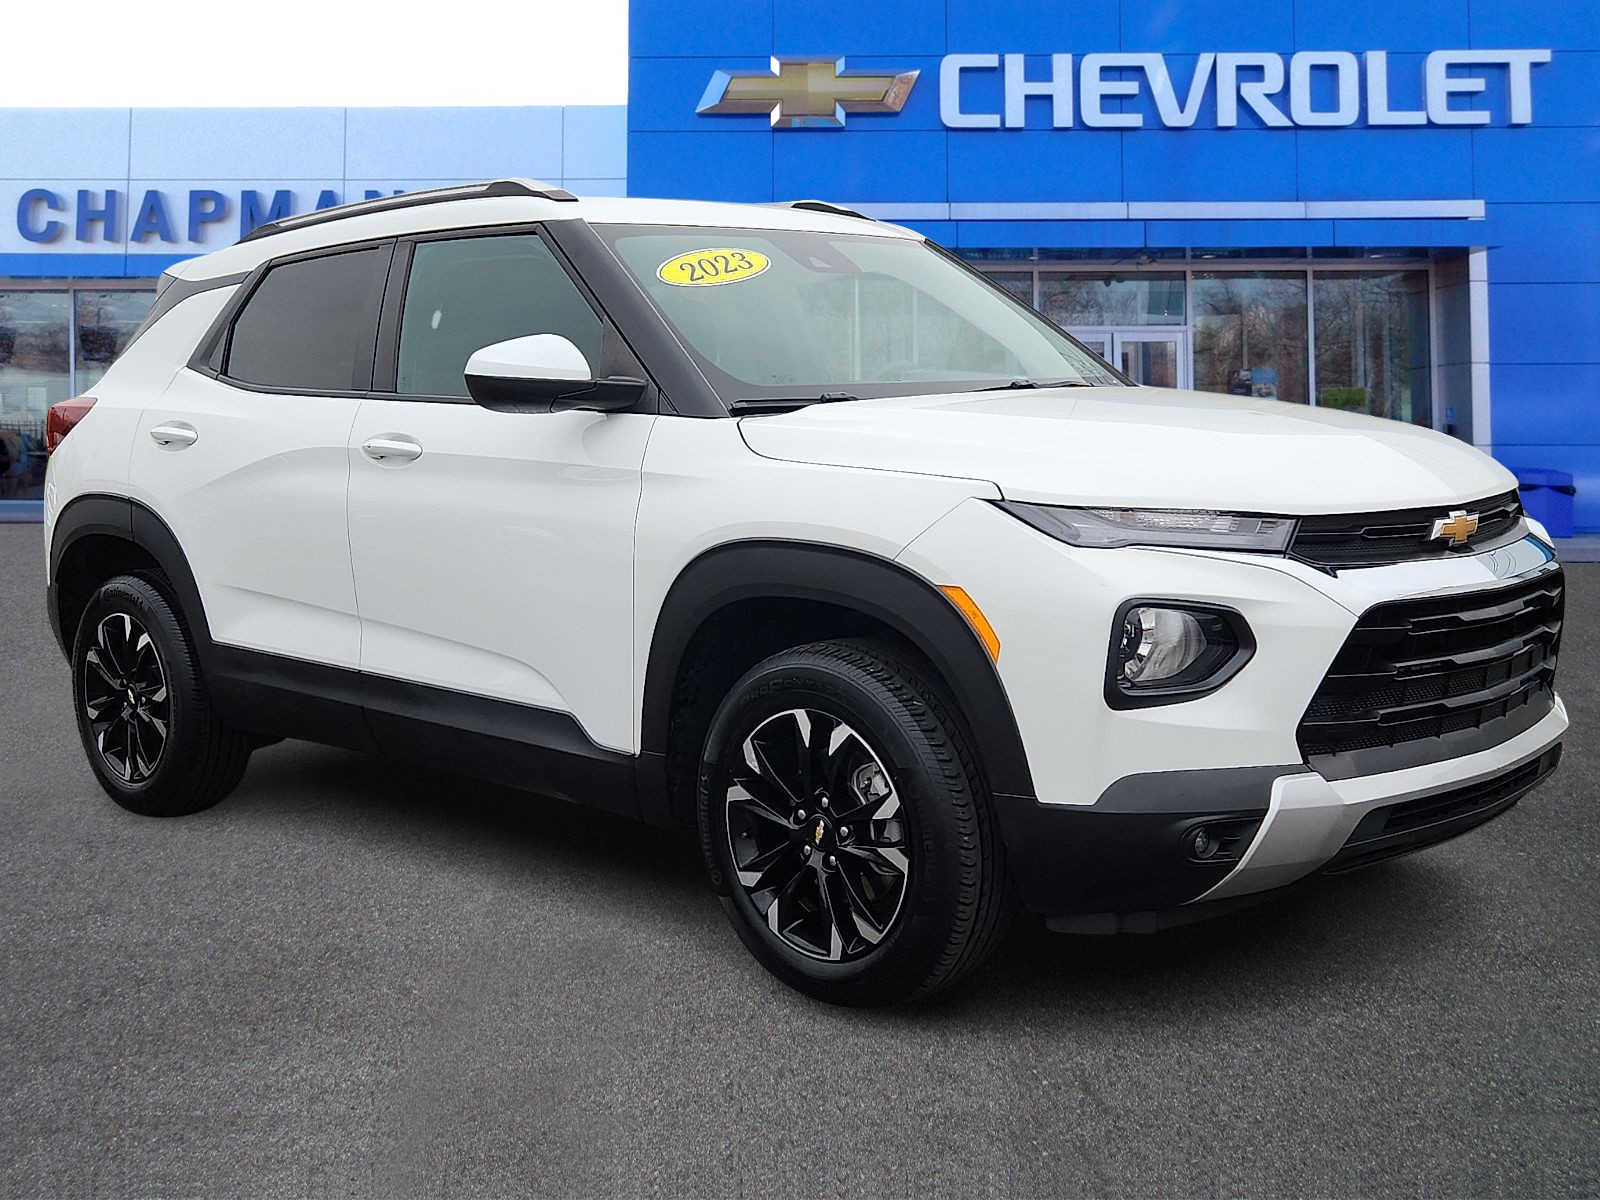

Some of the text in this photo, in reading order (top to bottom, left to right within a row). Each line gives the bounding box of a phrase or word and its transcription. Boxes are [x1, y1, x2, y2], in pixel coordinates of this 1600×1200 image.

[939, 49, 1552, 129] CHEVROLET
[16, 188, 405, 243] CHAPM
[679, 252, 753, 282] 2023
